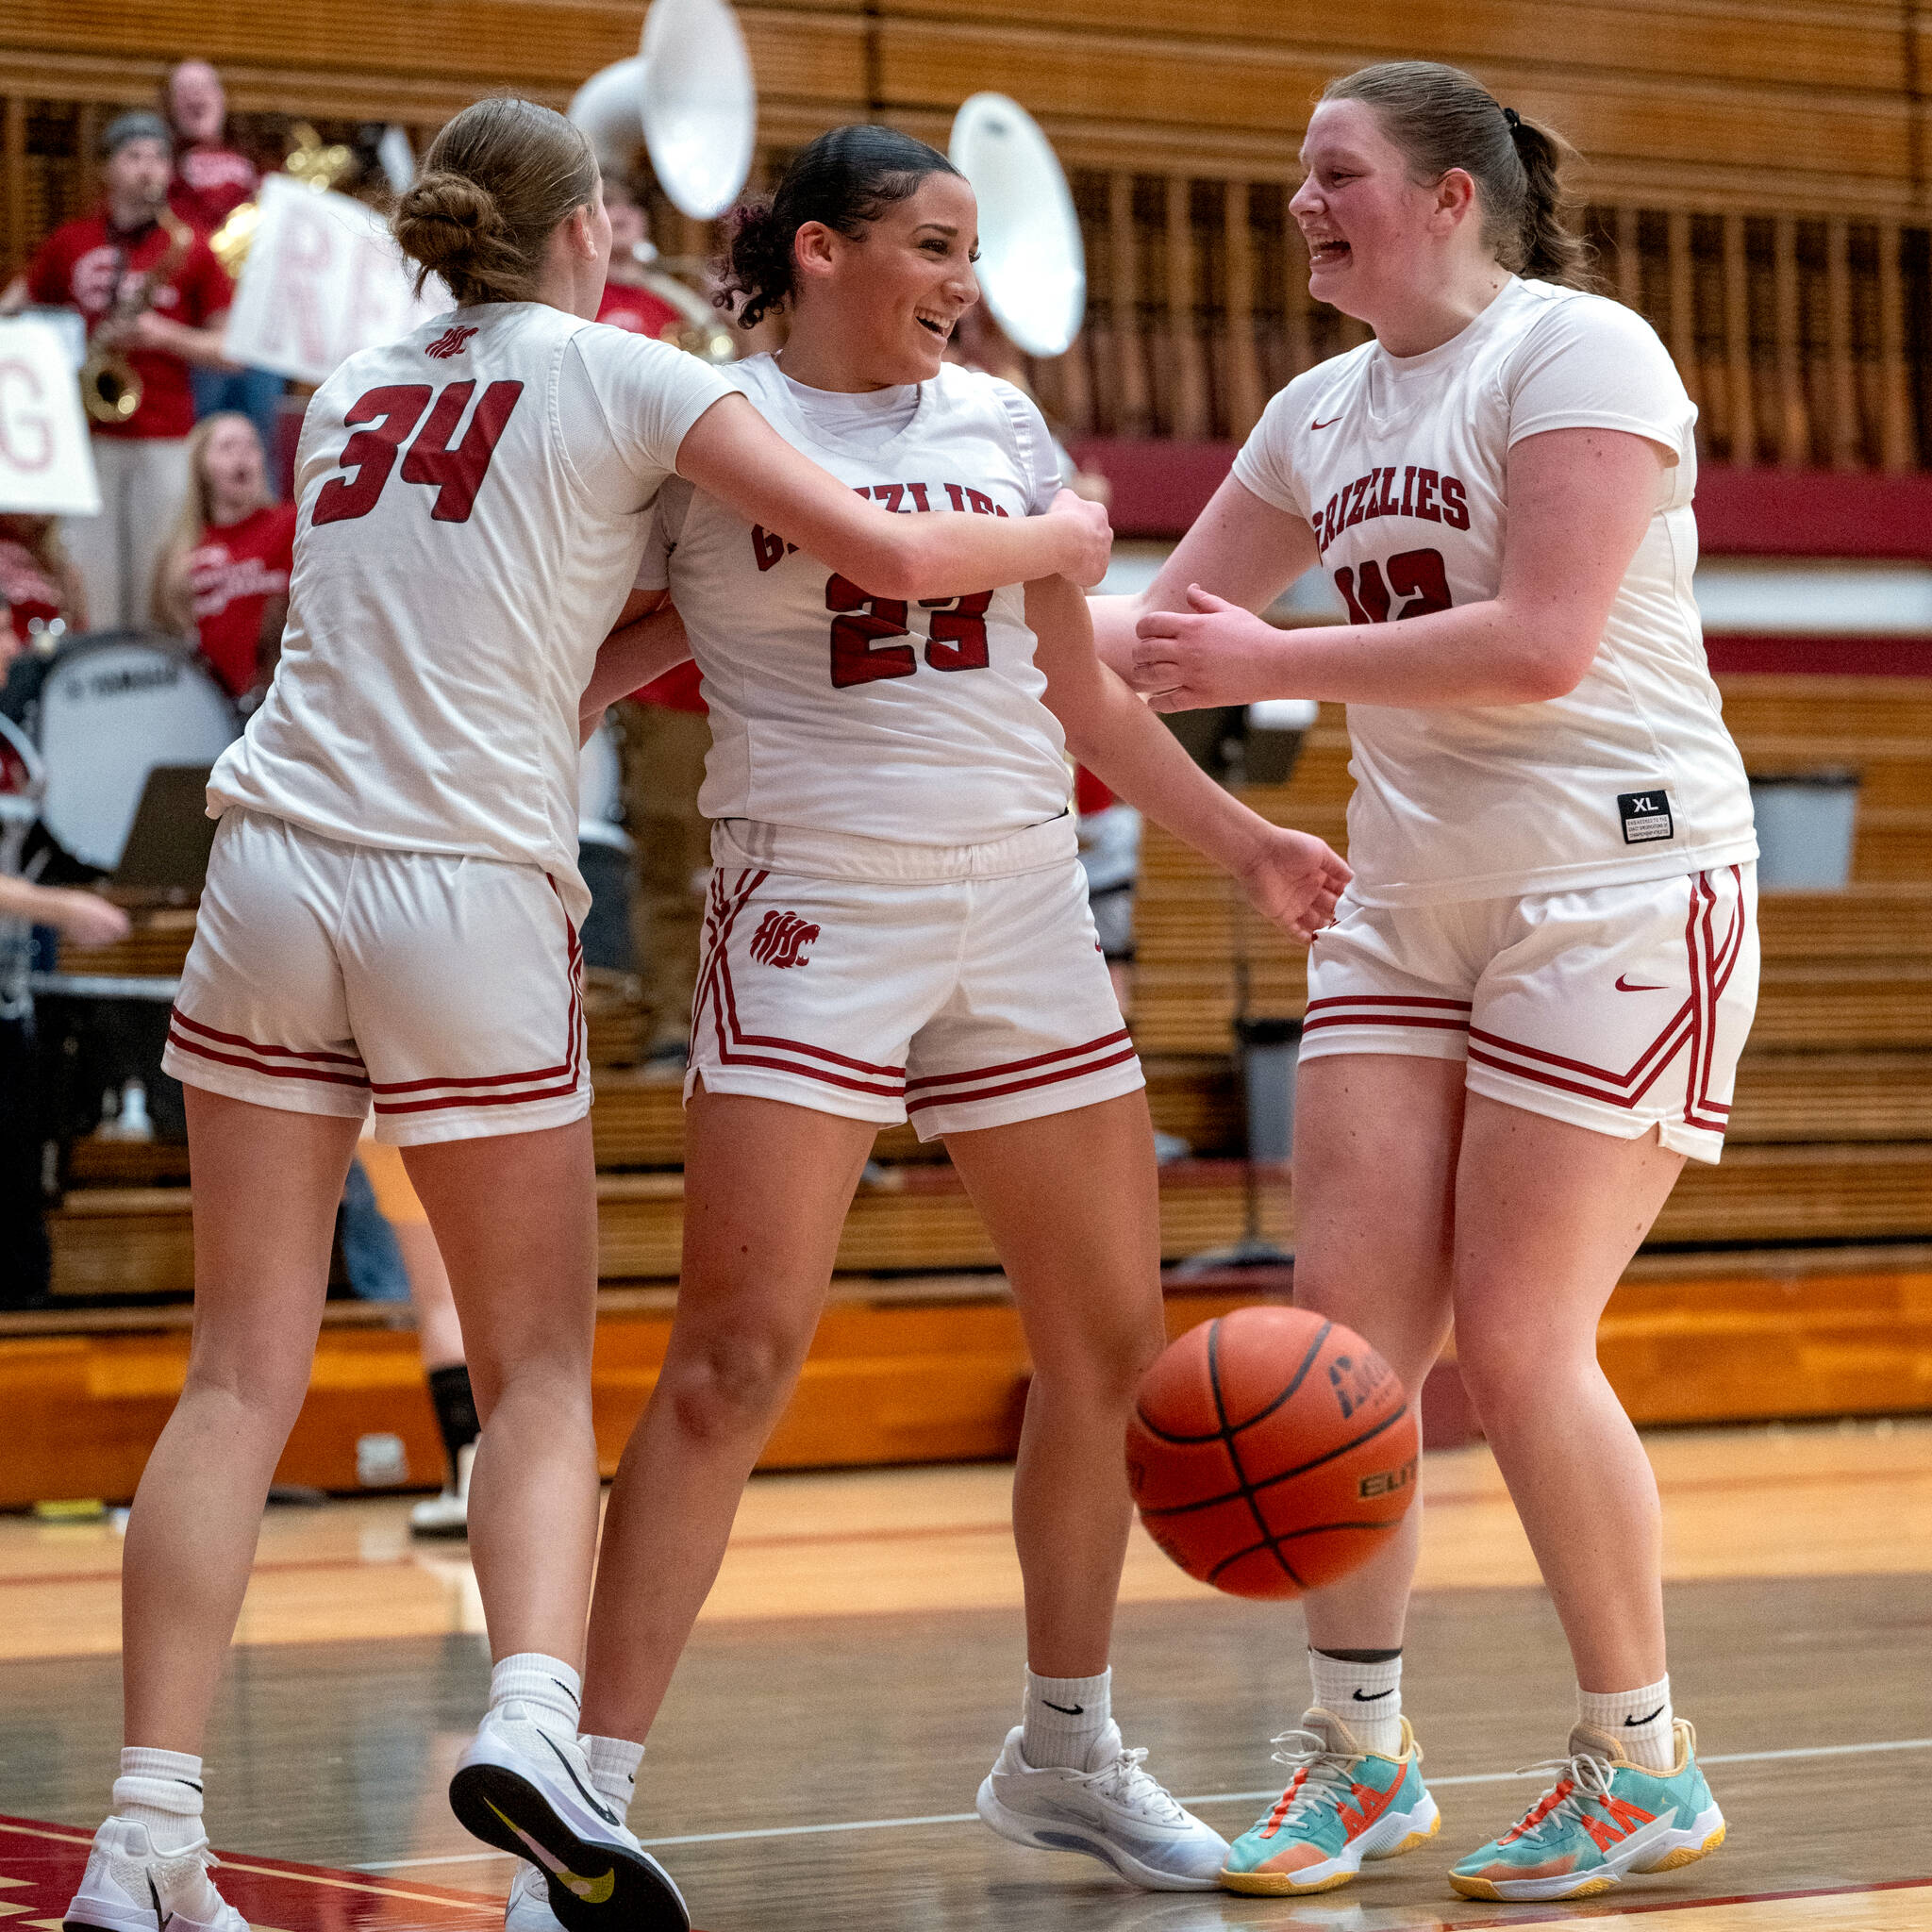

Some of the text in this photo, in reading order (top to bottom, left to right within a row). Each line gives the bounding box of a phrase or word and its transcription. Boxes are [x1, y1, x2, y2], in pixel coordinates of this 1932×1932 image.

[310, 378, 525, 527] 34
[824, 572, 994, 689] 23
[1632, 797, 1659, 812] XL
